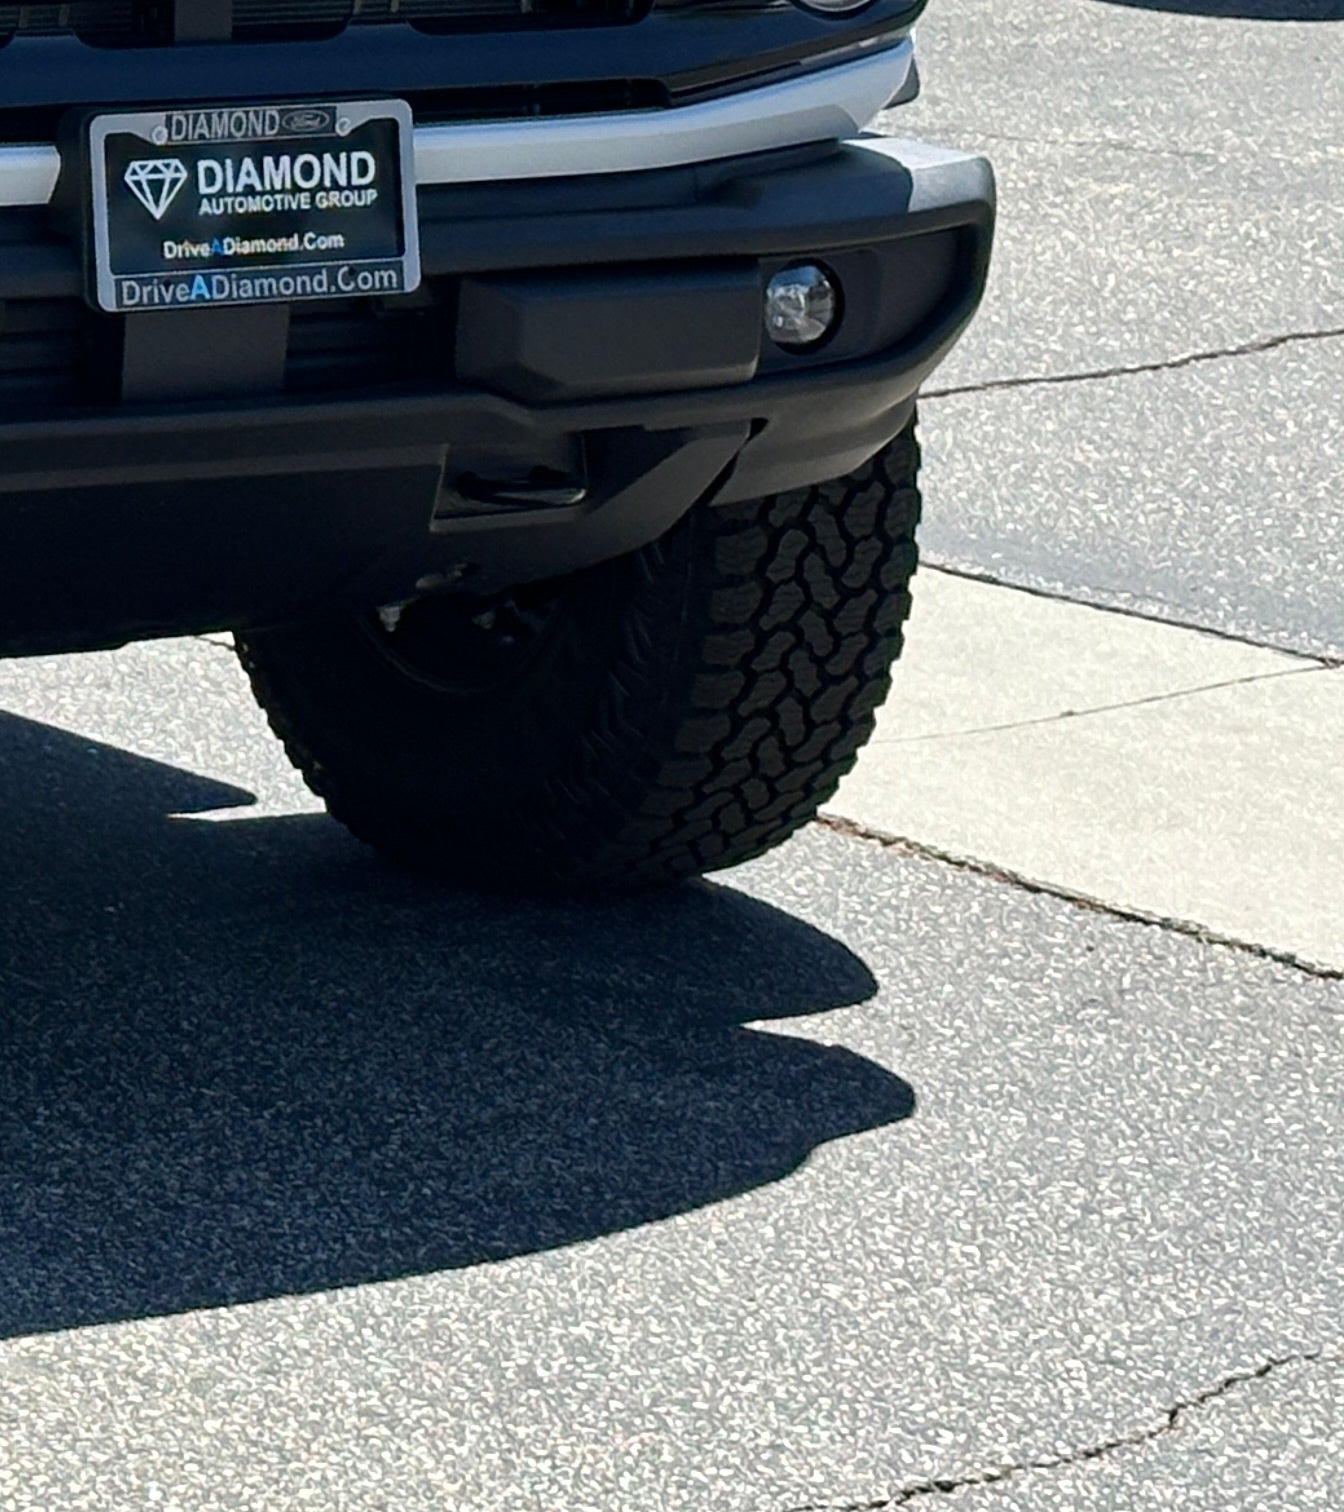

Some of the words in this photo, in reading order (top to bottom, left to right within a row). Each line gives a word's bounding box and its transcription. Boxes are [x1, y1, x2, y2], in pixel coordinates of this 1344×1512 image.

[171, 109, 280, 141] DIAMOND
[197, 150, 377, 195] DIAMOND
[198, 193, 311, 216] AUTOMOTIVE
[315, 188, 378, 209] GROUP
[163, 232, 345, 260] DriveADiamond.Com
[121, 265, 398, 307] DriveADiamond.Com
